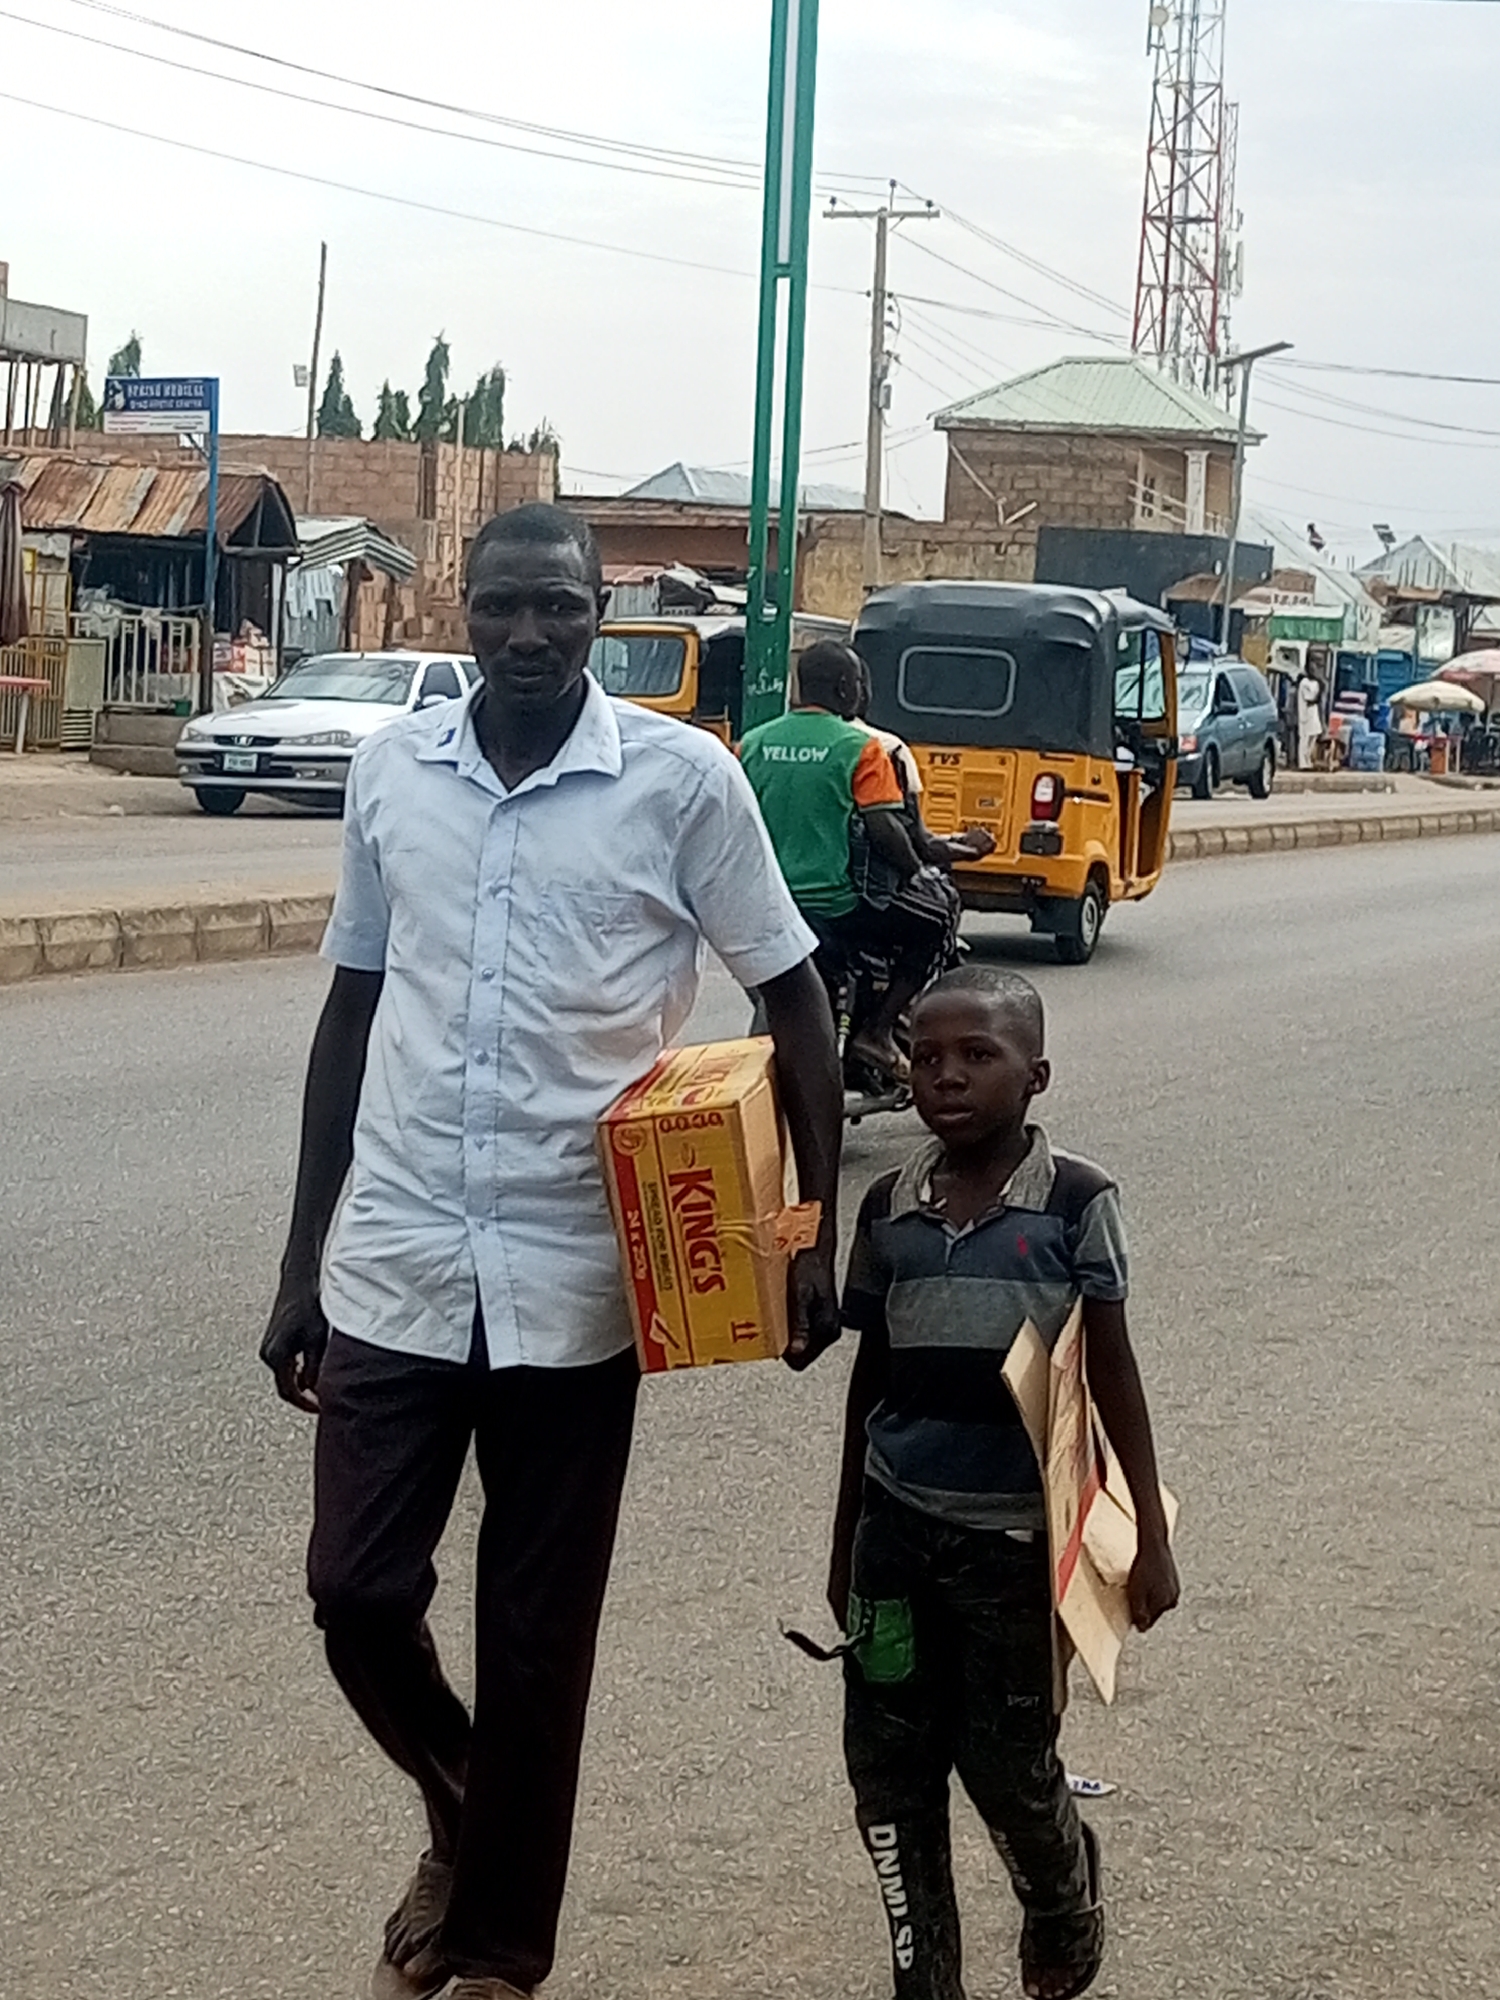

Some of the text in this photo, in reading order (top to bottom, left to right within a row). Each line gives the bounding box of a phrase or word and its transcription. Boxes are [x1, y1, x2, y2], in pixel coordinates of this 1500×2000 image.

[762, 746, 828, 763] YELLOW
[928, 752, 962, 766] TVS
[668, 1169, 726, 1294] KING'S
